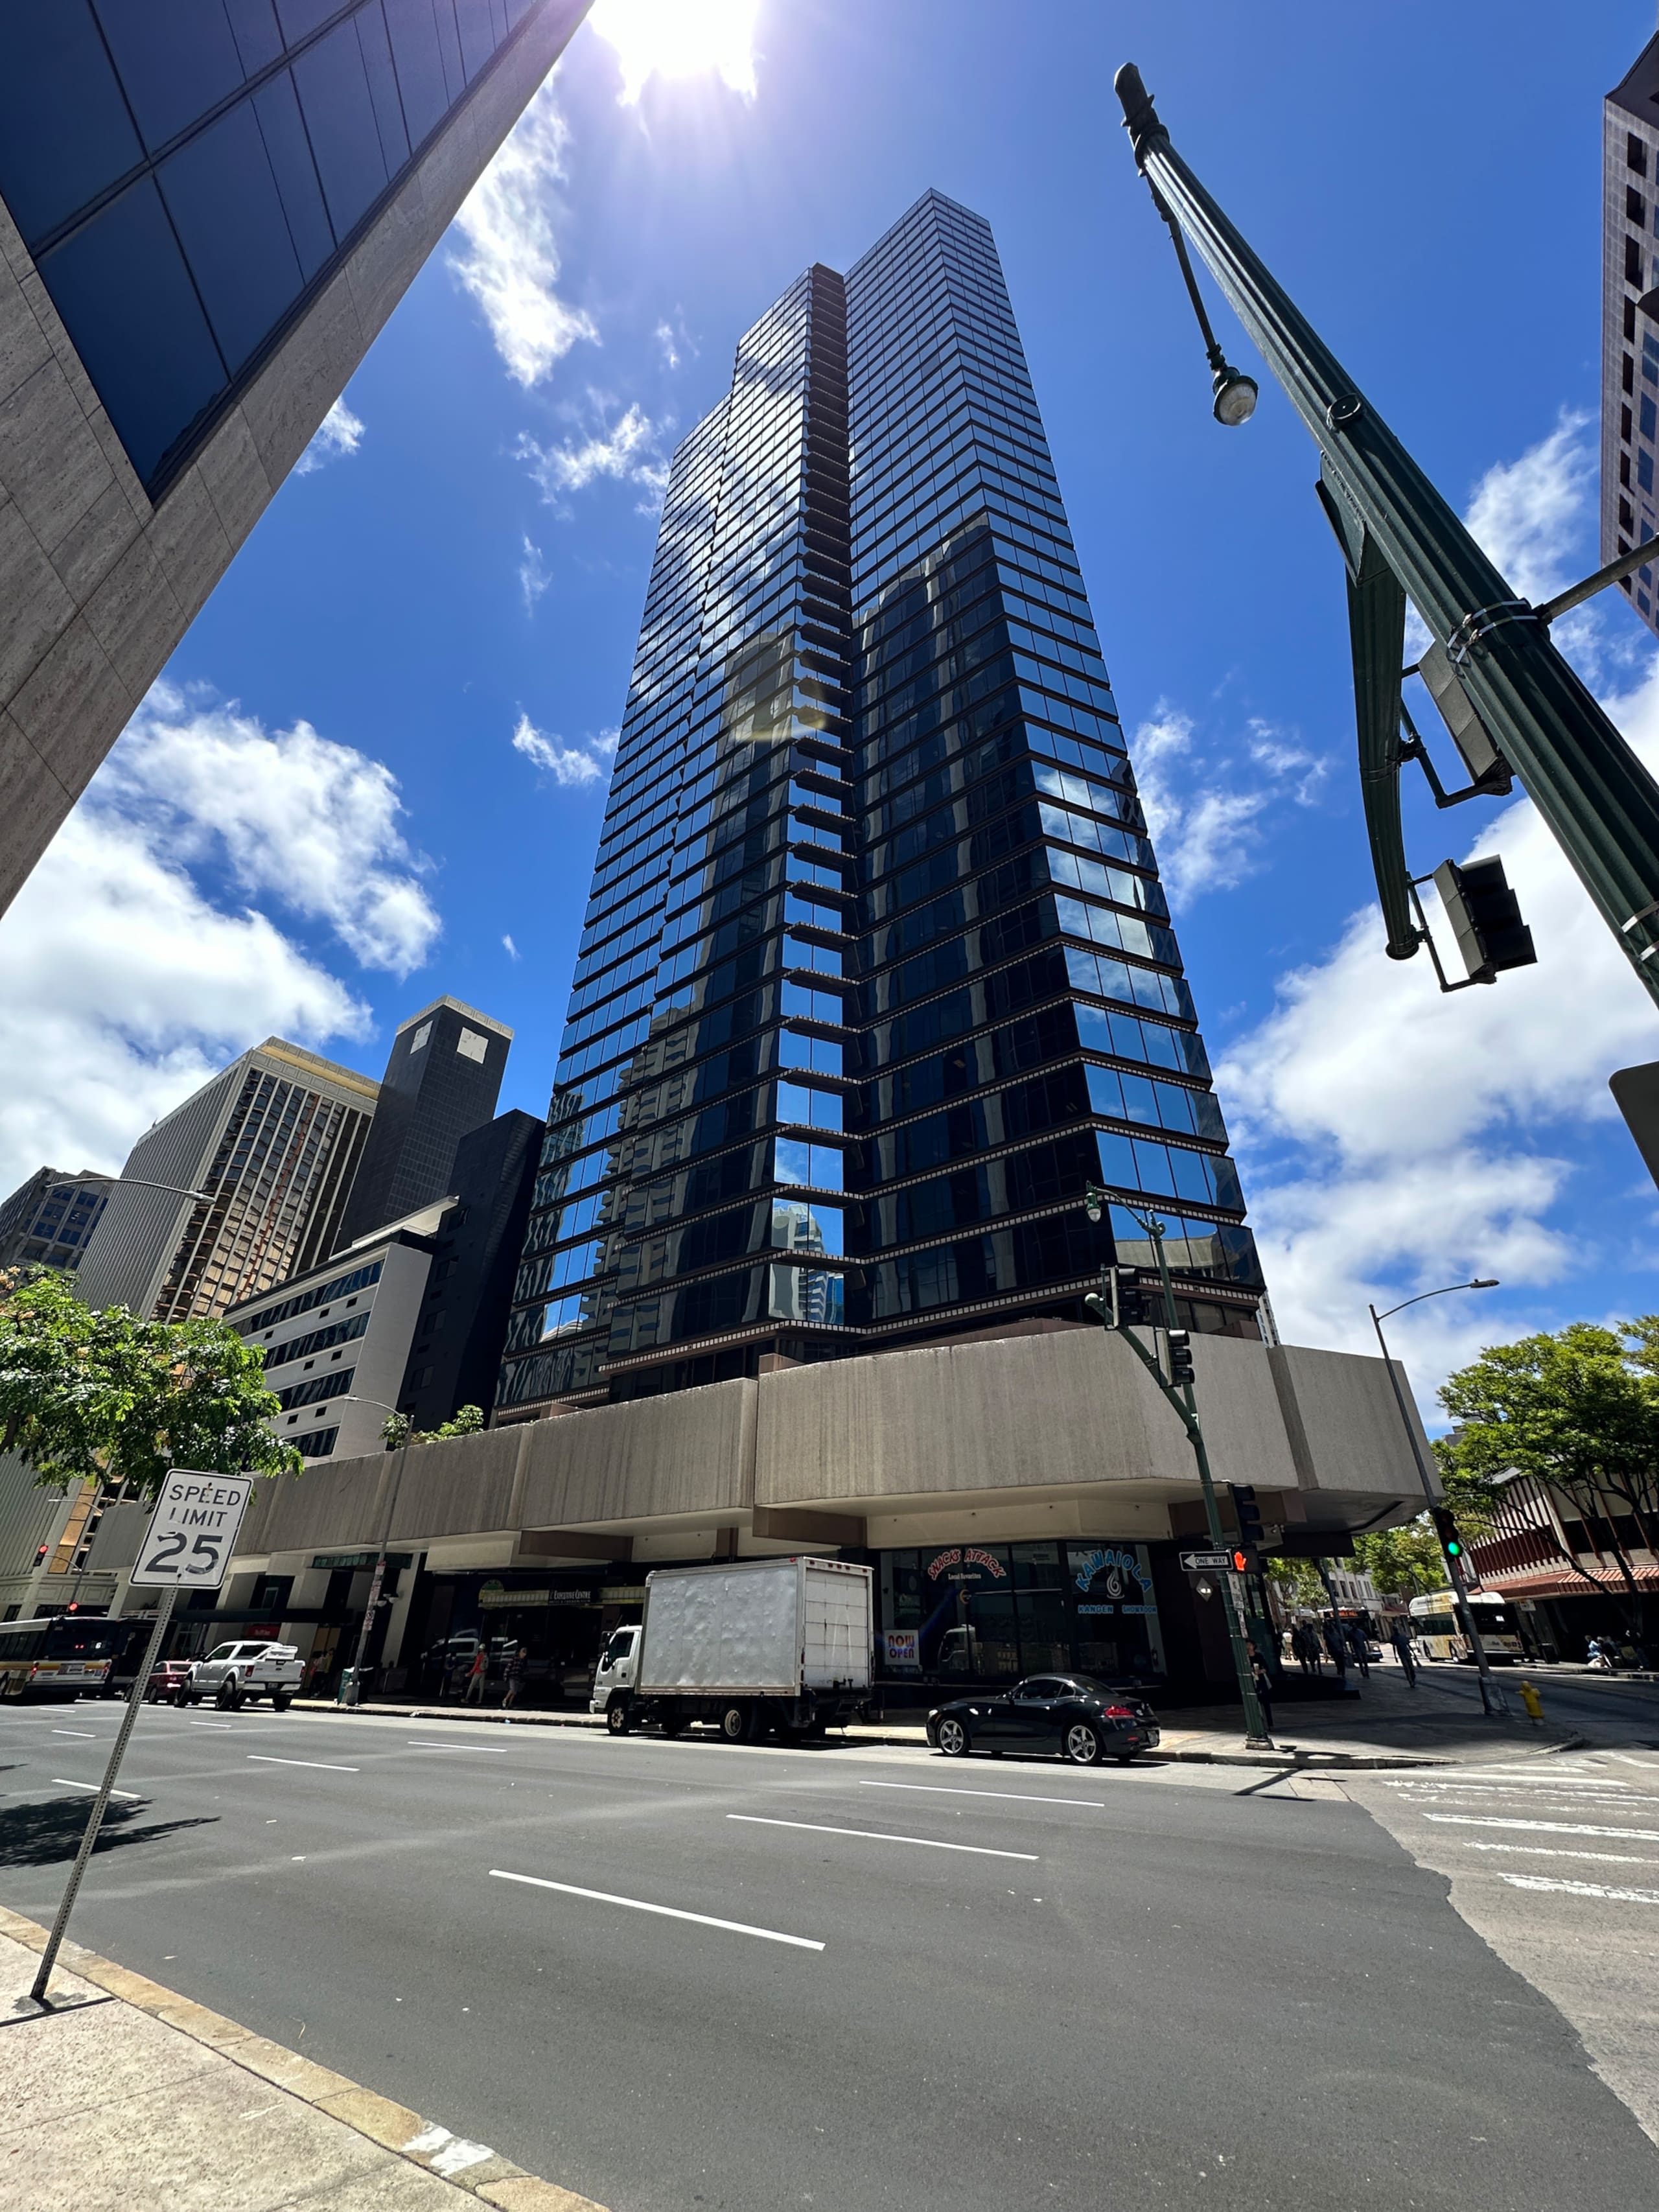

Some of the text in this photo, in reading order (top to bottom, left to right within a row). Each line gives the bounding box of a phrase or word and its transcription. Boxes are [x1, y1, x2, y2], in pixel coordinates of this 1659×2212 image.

[168, 1483, 241, 1506] SPEED
[168, 1507, 228, 1528] LIMIT
[144, 1531, 224, 1575] 25
[928, 1548, 1006, 1581] SNACKS ATTACK
[1076, 1549, 1153, 1592] KAWAIOLA
[1078, 1605, 1113, 1614] KANGEN
[889, 1648, 914, 1659] OPEN
